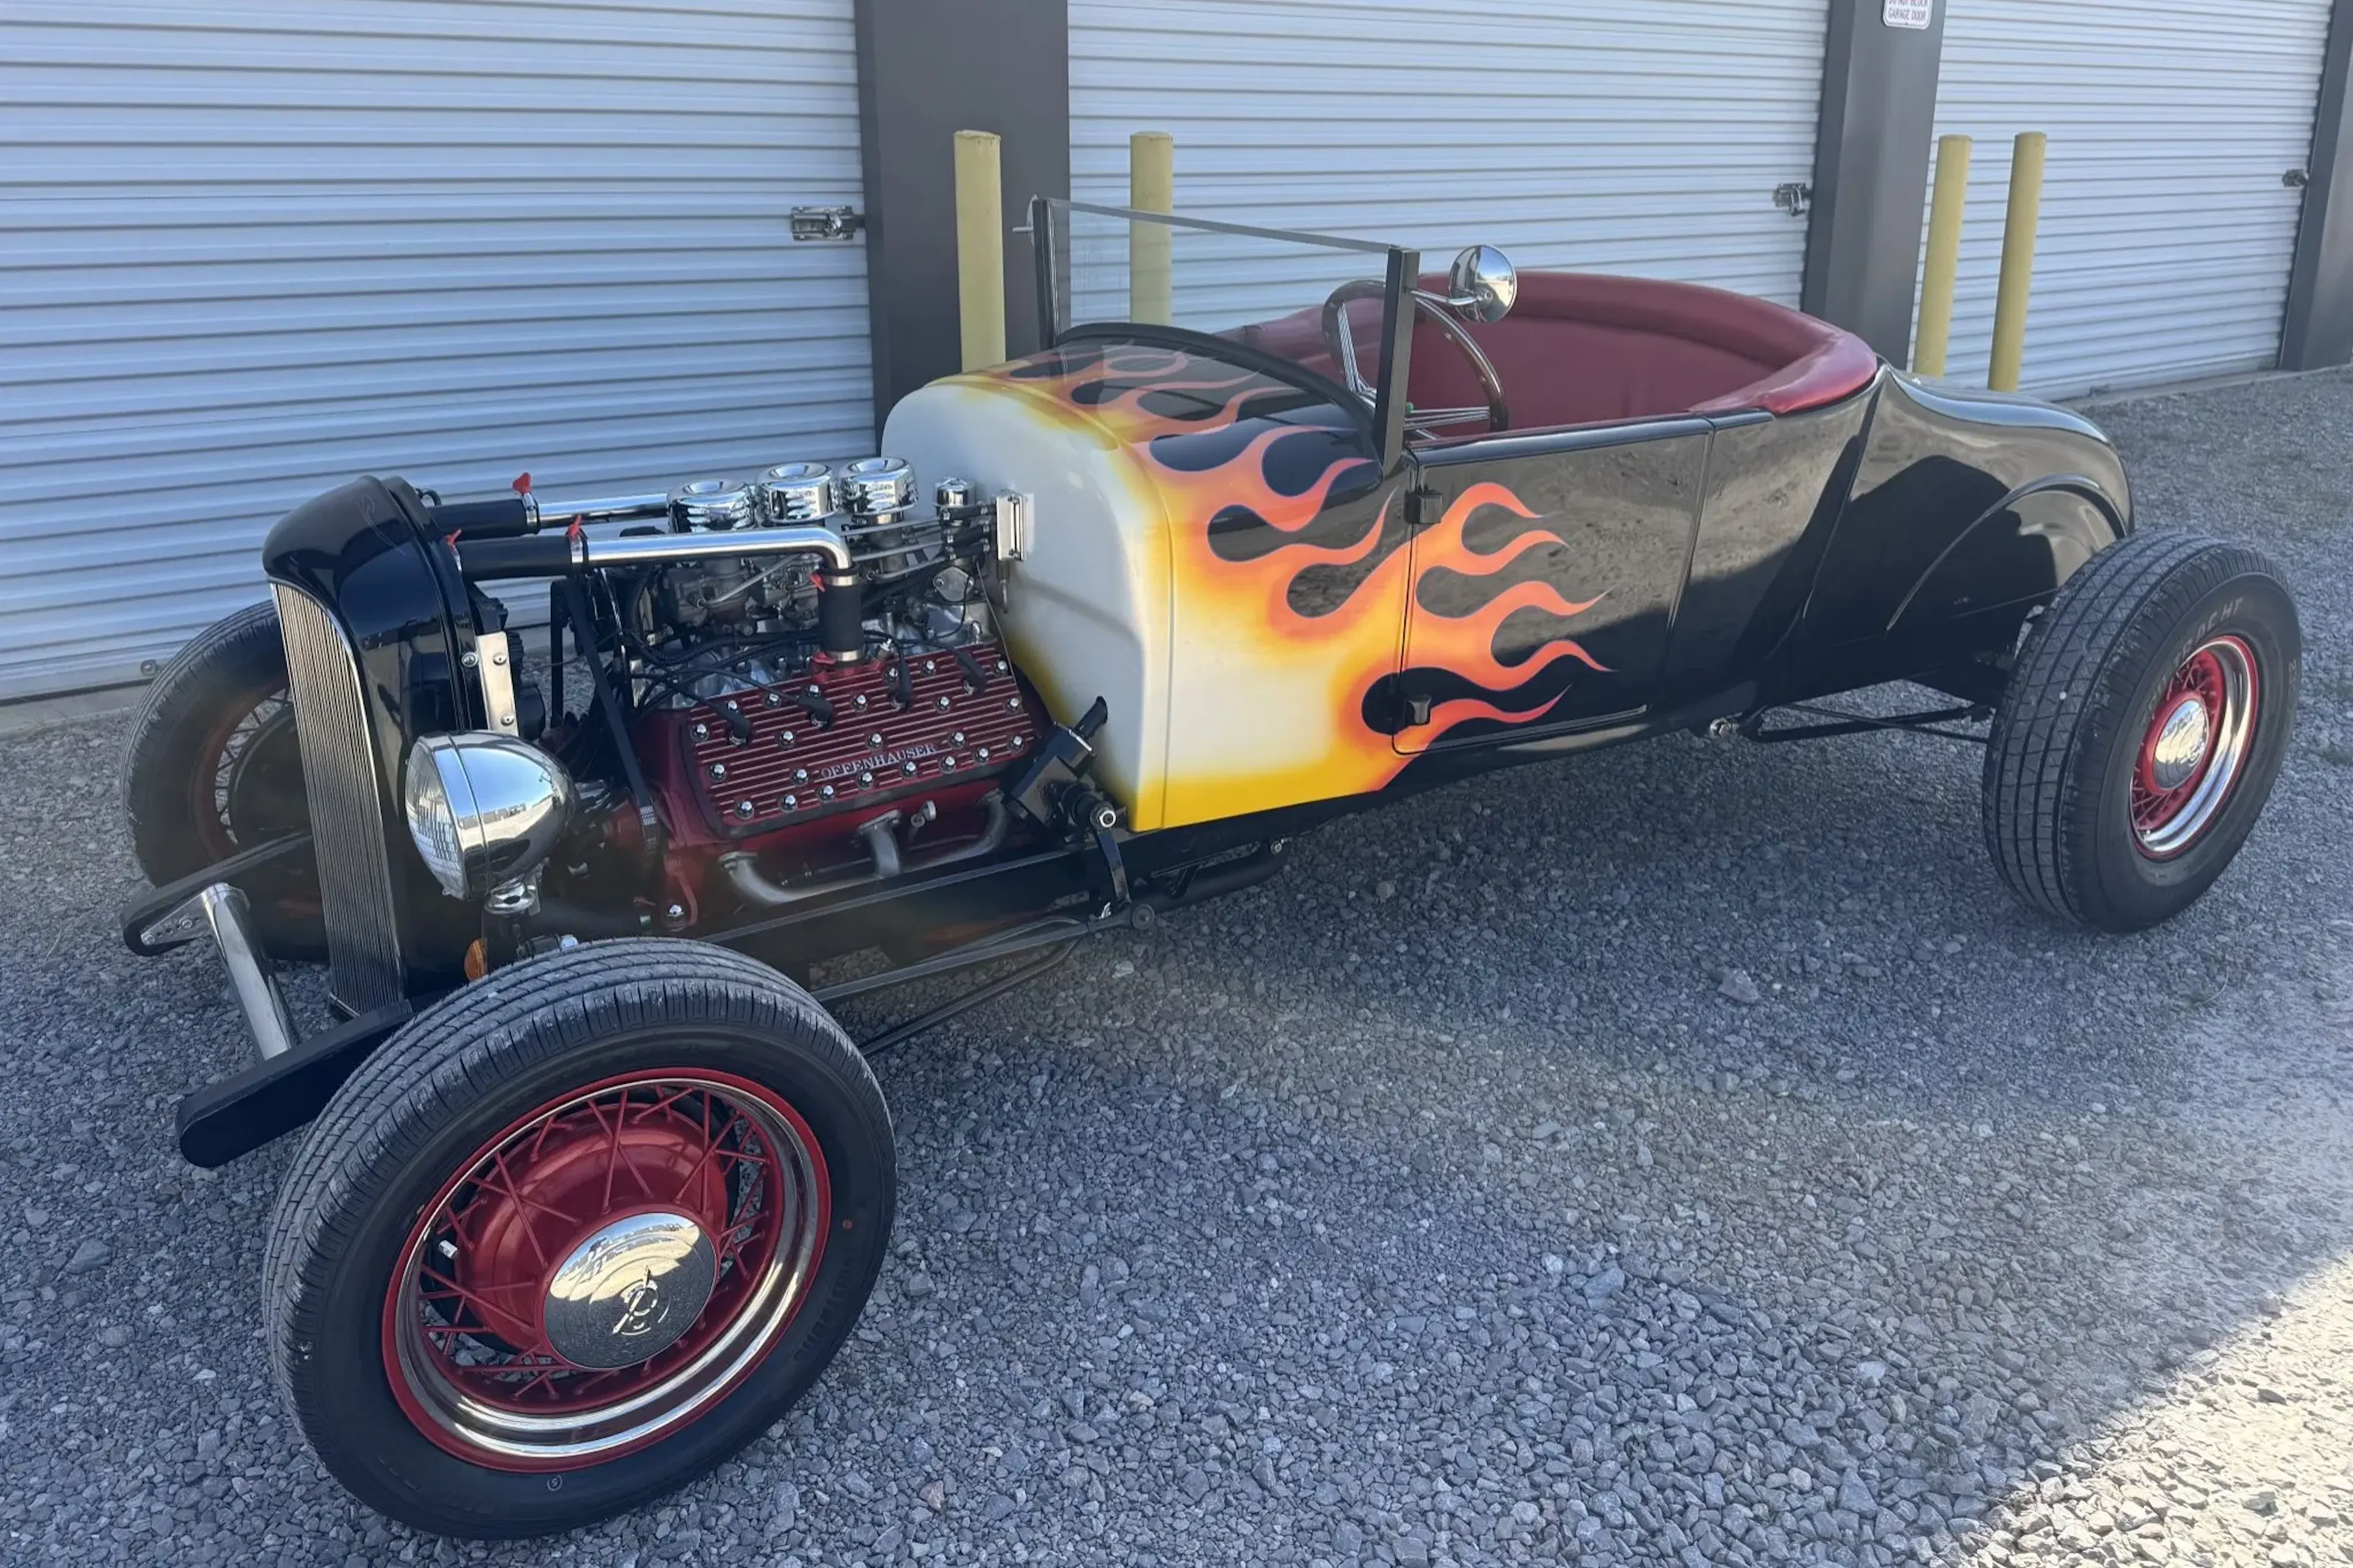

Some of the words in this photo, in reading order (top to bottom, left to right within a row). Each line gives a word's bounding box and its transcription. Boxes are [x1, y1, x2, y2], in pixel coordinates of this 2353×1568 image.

[1888, 7, 1909, 20] GARAGE
[1911, 10, 1927, 20] DOOR
[820, 742, 937, 779] OFFENHAUSER
